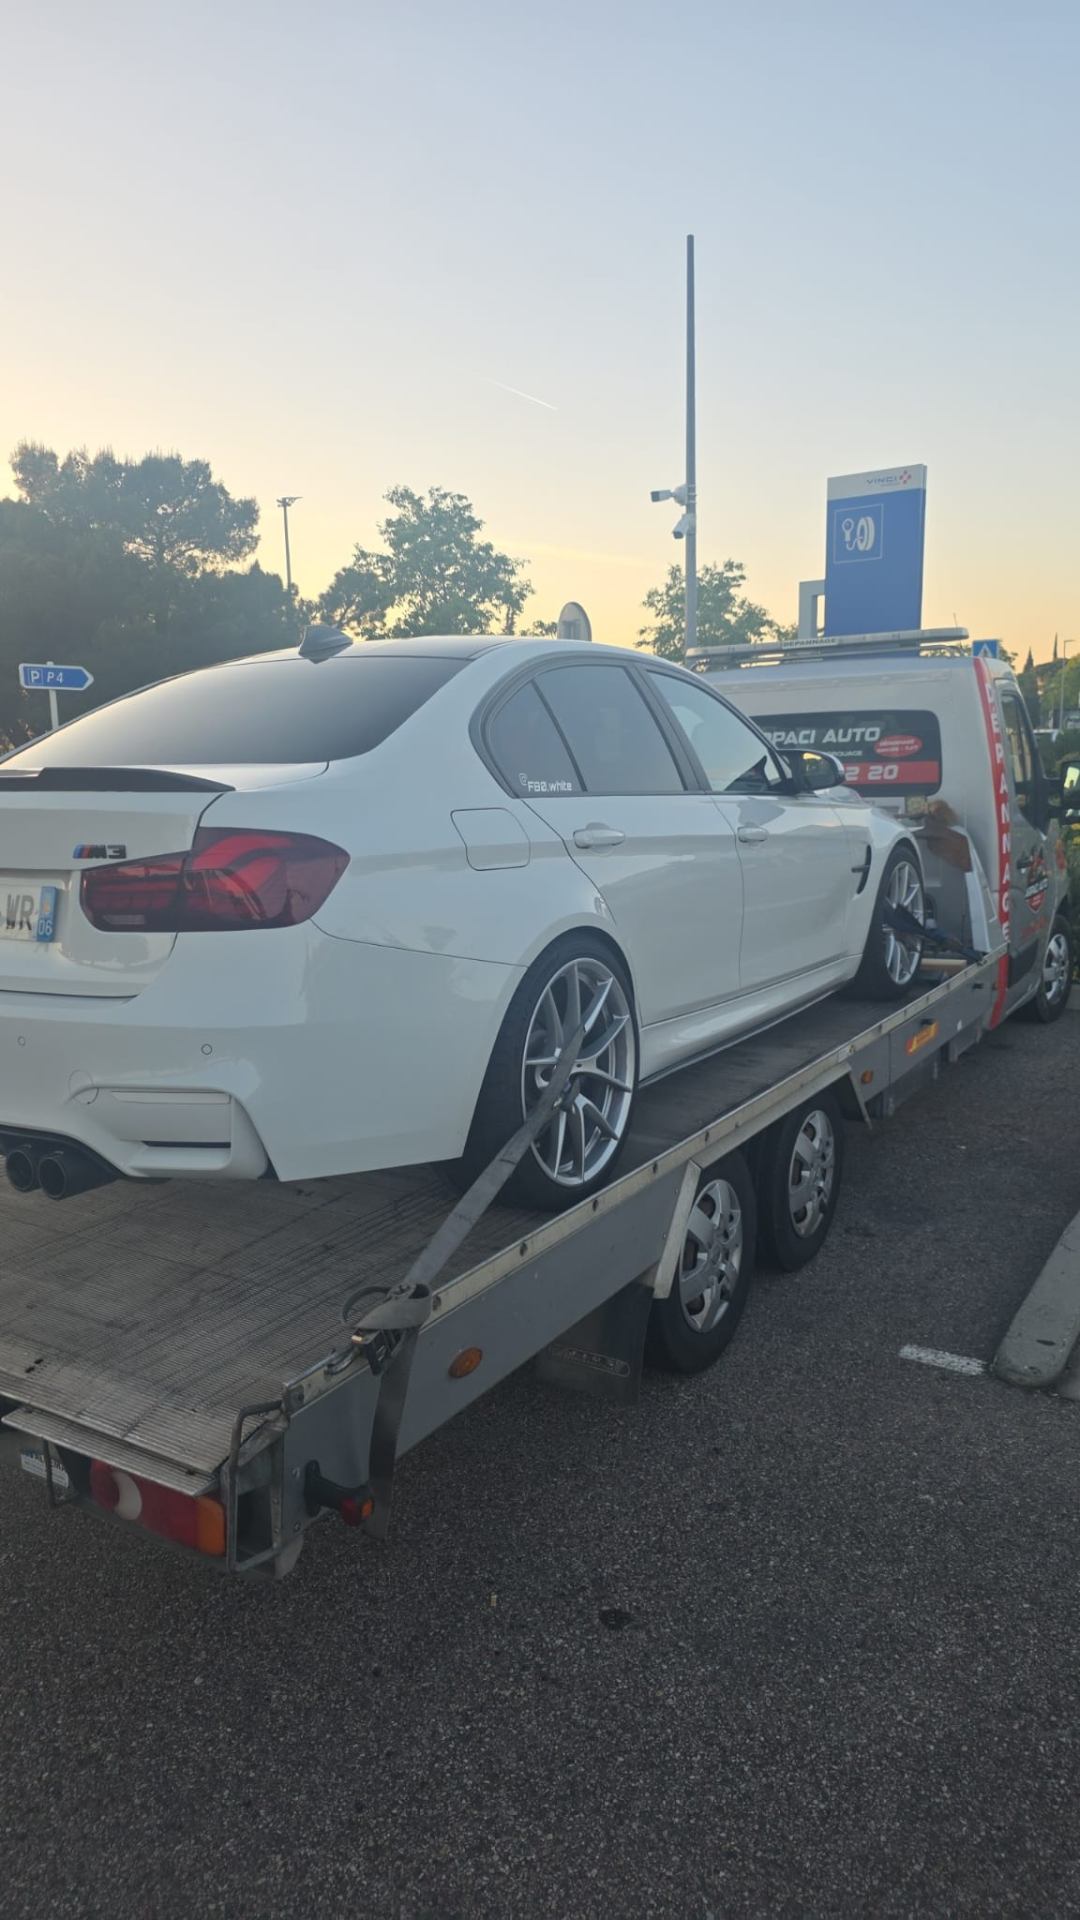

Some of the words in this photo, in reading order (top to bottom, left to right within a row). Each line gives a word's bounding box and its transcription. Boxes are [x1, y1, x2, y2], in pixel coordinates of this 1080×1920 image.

[30, 670, 40, 683] P
[822, 727, 881, 744] AUTO
[867, 764, 899, 781] 20
[38, 919, 53, 937] 06
